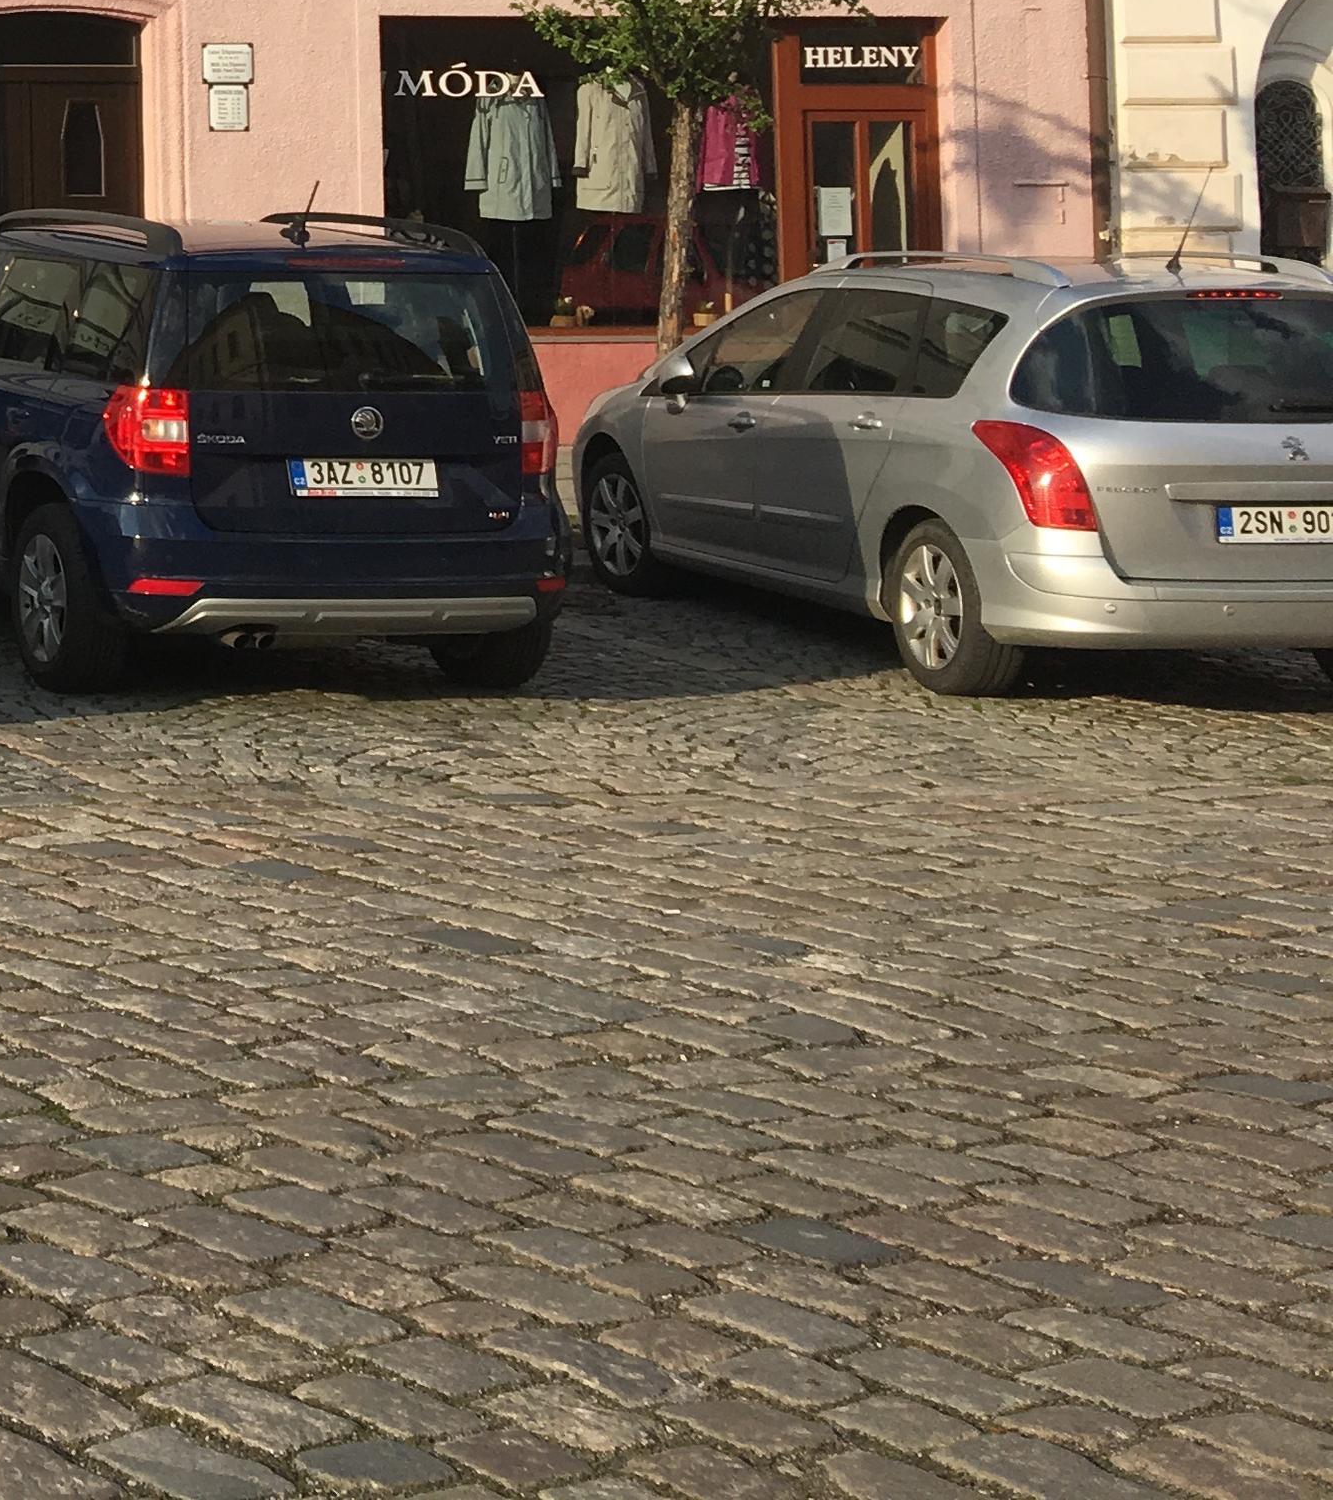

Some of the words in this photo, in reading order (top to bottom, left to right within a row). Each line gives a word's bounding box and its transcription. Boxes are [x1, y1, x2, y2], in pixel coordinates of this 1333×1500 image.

[803, 46, 920, 68] HELENY
[394, 62, 545, 97] MÓDA
[310, 462, 354, 485] 3AZ
[370, 461, 425, 485] 8107
[1239, 510, 1283, 534] 2SN
[1302, 510, 1333, 534] 90
